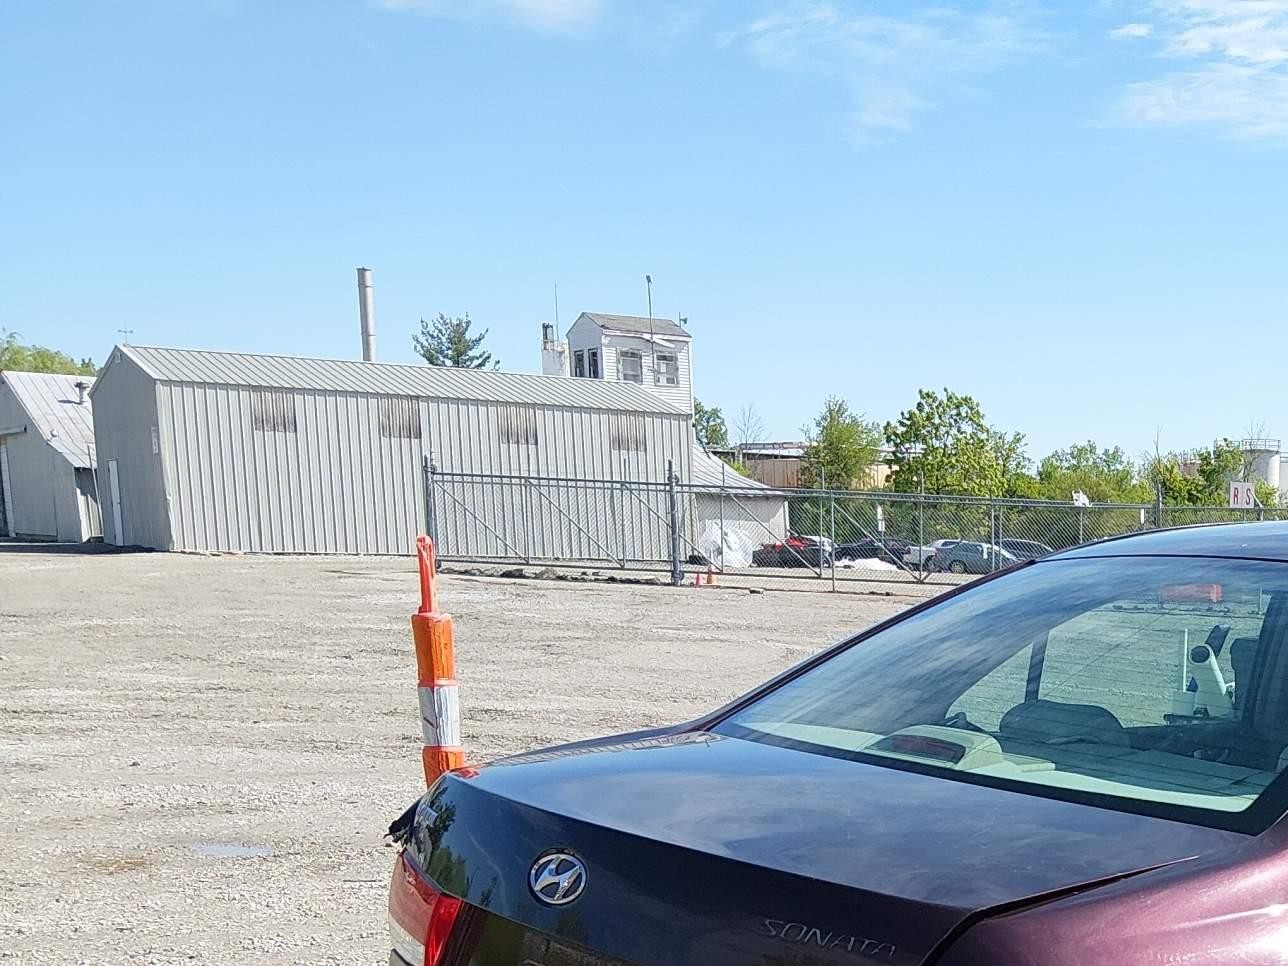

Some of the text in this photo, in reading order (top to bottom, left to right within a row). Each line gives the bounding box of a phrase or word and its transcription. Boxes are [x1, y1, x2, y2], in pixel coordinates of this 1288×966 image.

[1233, 486, 1252, 506] R S
[763, 918, 898, 959] SONATA
